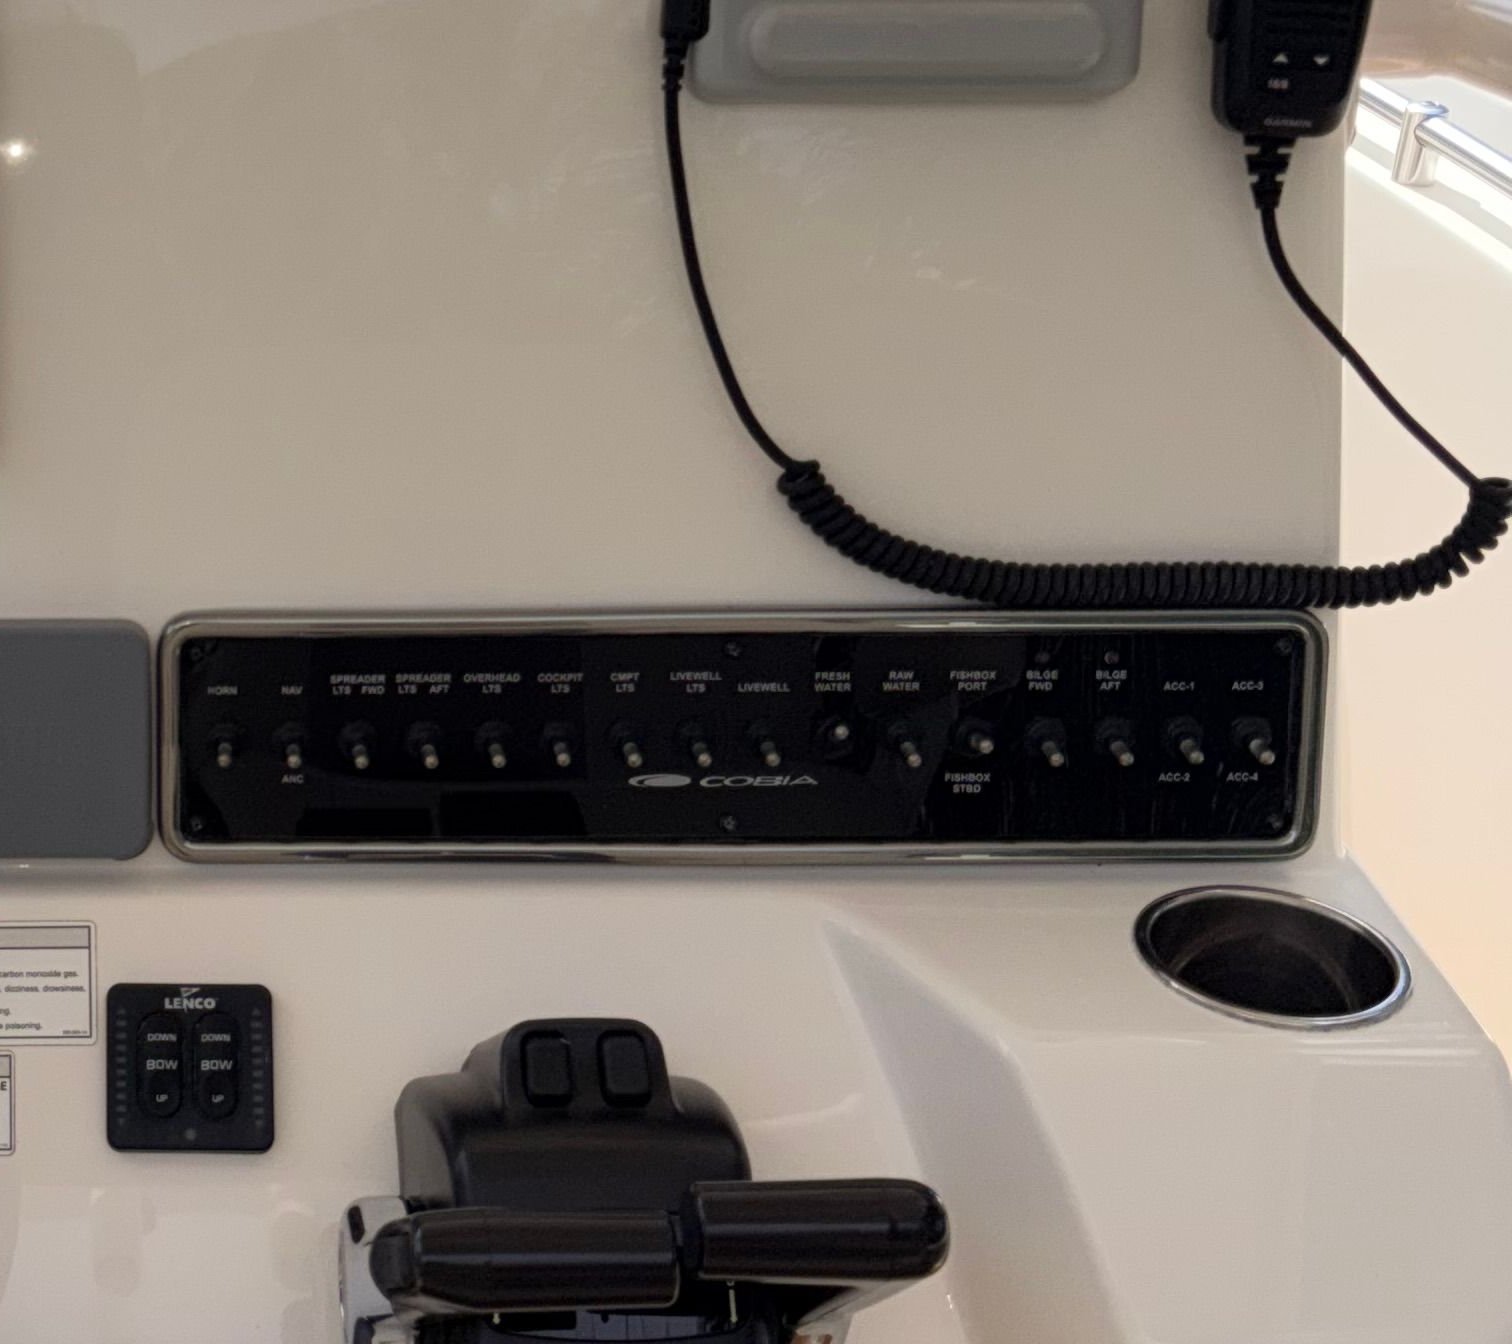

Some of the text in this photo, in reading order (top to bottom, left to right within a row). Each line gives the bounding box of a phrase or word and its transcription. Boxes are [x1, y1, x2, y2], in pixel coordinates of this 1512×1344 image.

[329, 673, 386, 684] SPREADER
[395, 672, 452, 683] SPREADER
[463, 672, 522, 683] OVERHEAD
[537, 672, 584, 683] COCKPIT
[610, 671, 641, 682] CMPT
[670, 671, 723, 681] LIVEWELL
[814, 671, 851, 681] FRESH
[888, 670, 915, 680] RAW
[949, 670, 997, 680] FISHBOX
[1025, 669, 1059, 680] BILGE
[1095, 669, 1128, 680] BILGE
[207, 685, 239, 696] HORN
[280, 685, 304, 696] NAV
[332, 685, 386, 696] LTS FWD
[397, 684, 450, 695] LTS AFT
[482, 684, 502, 694] LTS
[550, 683, 571, 694] LTS
[615, 683, 636, 693] LTS
[686, 682, 707, 693] LTS
[737, 682, 791, 693] LIVEWELL
[814, 682, 852, 693] WATER
[882, 681, 921, 692] WATER
[957, 681, 988, 691] PORT
[1028, 681, 1054, 691] FWD
[1099, 681, 1122, 691] AFT
[281, 774, 305, 785] ANC
[699, 775, 819, 788] COBIA
[944, 772, 992, 783] FISHBOX
[952, 783, 982, 794] STBD
[164, 997, 217, 1010] LENCO
[146, 1033, 178, 1043] DOWN
[200, 1033, 231, 1043] DOWN
[145, 1059, 179, 1071] BOW
[200, 1059, 233, 1071] BOW
[155, 1093, 169, 1103] UP
[211, 1093, 225, 1103] UP
